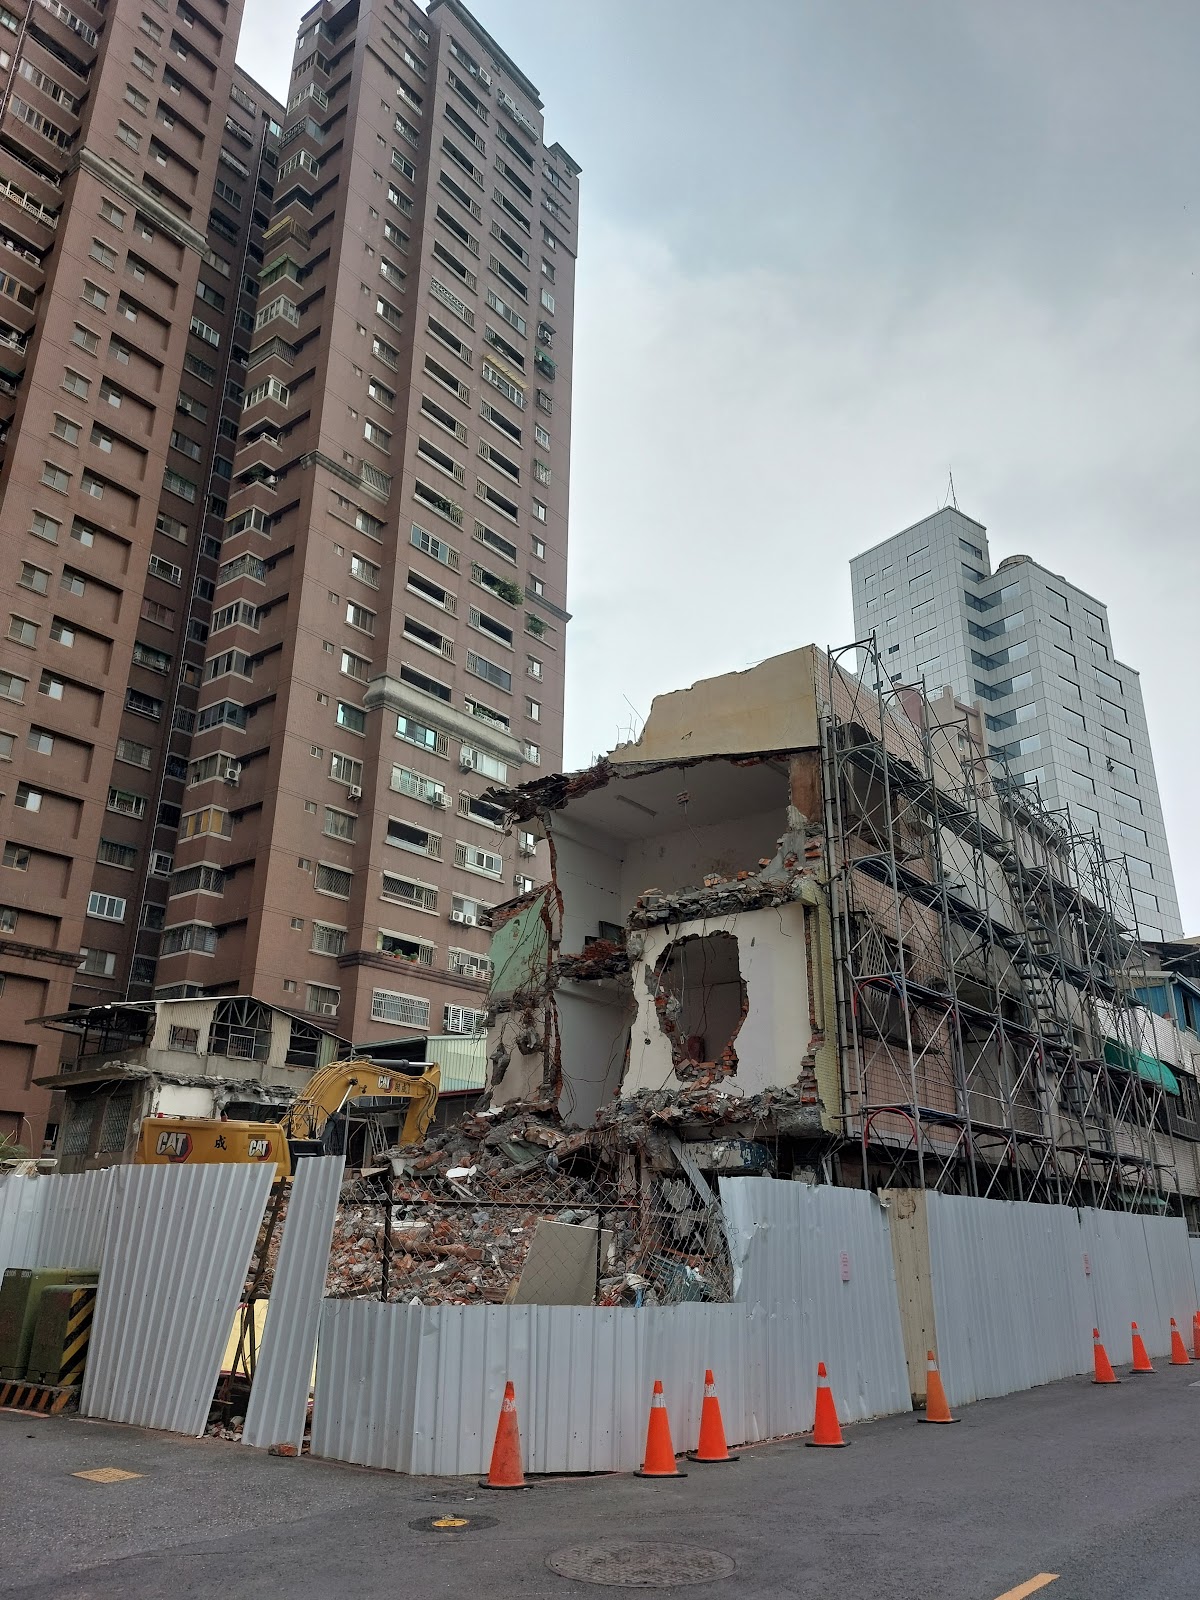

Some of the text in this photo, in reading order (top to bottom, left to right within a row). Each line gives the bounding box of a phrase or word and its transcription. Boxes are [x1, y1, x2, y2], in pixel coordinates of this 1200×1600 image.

[378, 1075, 391, 1089] CAT
[156, 1131, 187, 1156] CAT
[214, 1135, 228, 1151] 成
[248, 1139, 269, 1157] CAT
